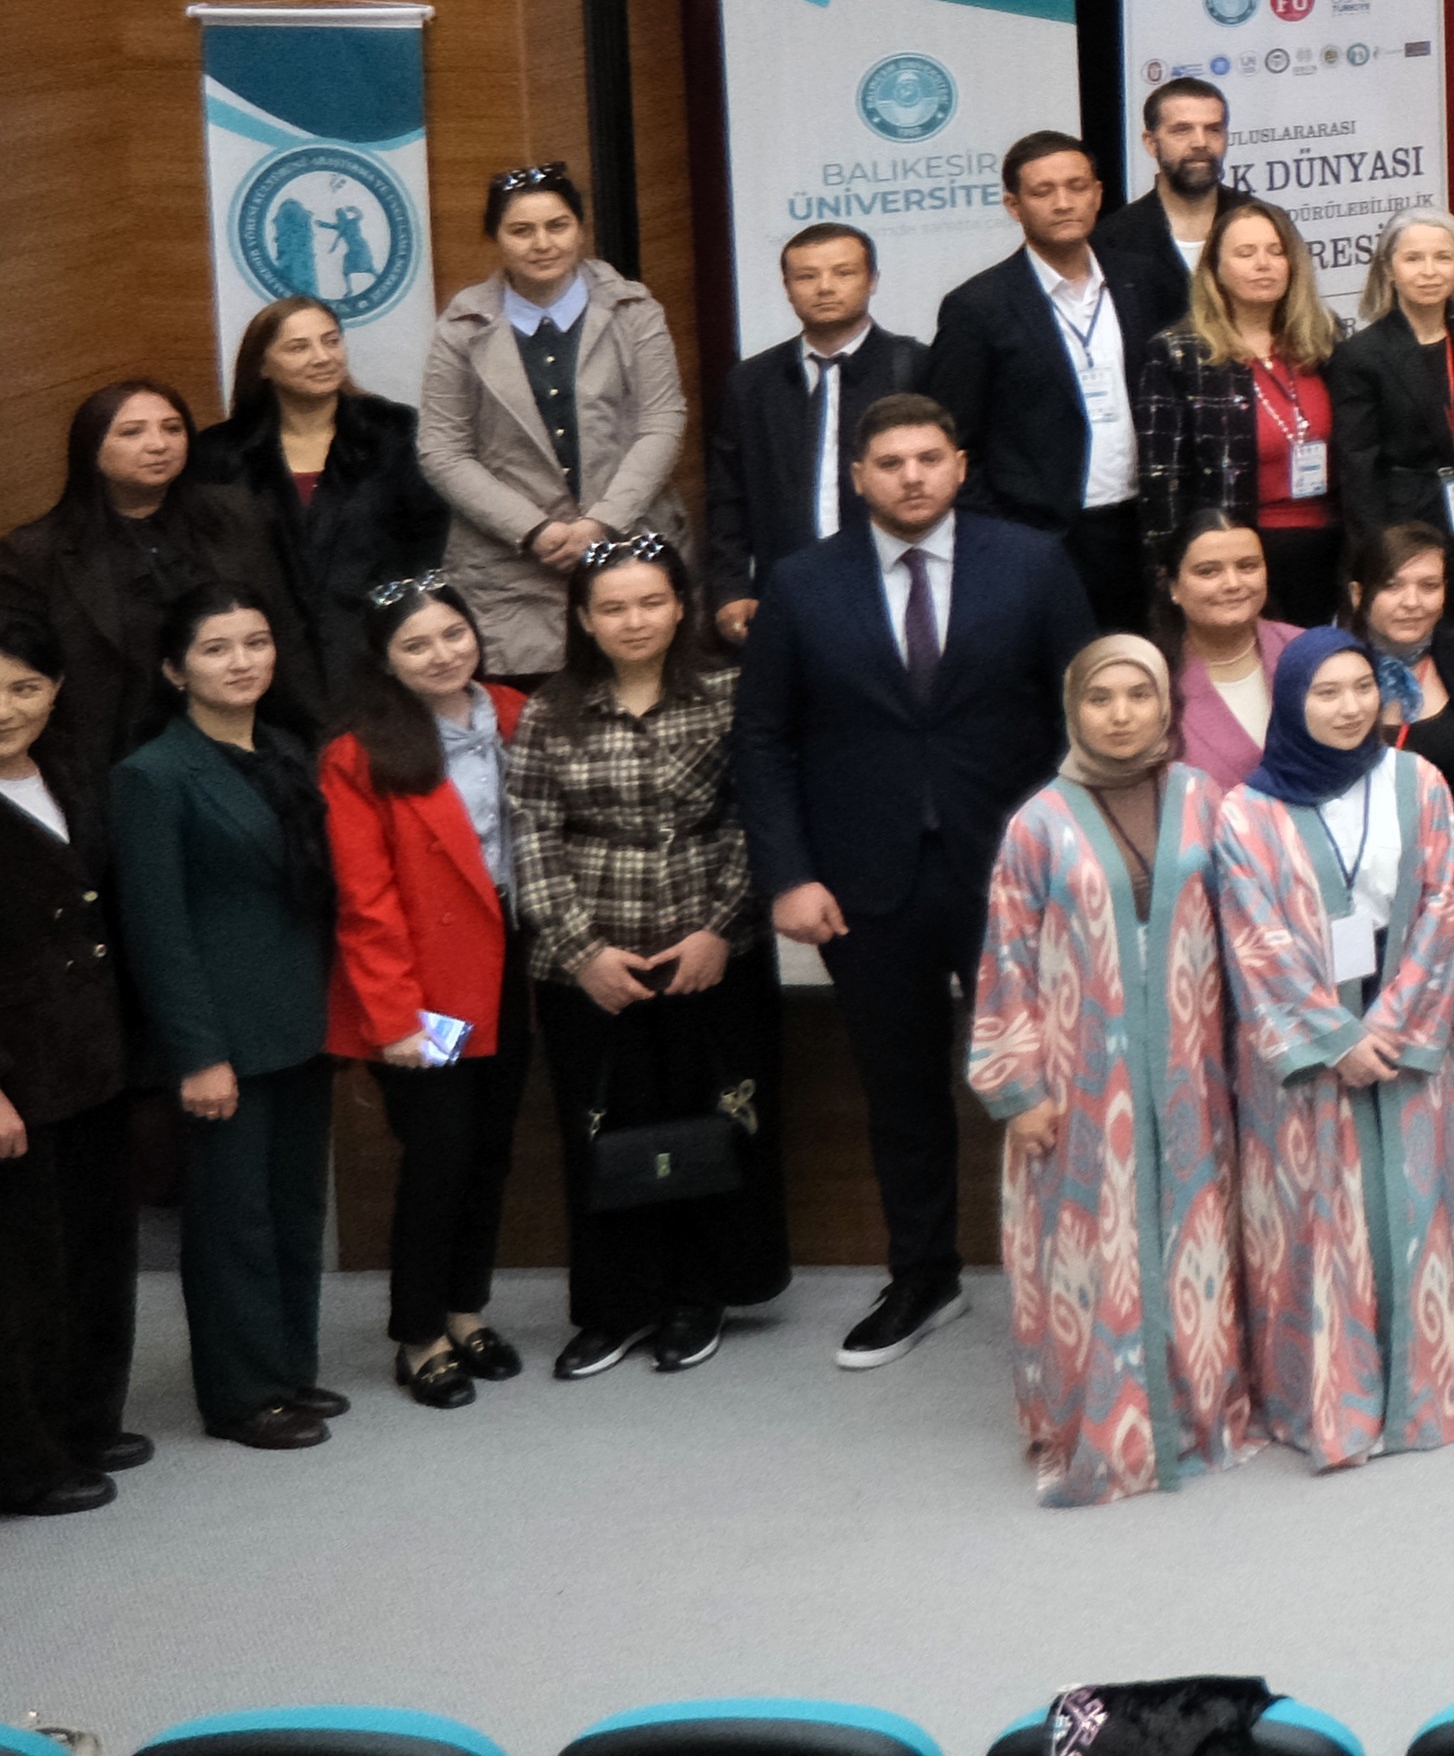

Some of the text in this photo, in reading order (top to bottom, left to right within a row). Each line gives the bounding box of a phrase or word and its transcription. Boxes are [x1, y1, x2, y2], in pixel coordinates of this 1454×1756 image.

[822, 149, 998, 187] BALIKESİR
[1266, 146, 1424, 192] DÜNYASI
[788, 180, 1001, 221] ÜNİVERSİTE
[1290, 192, 1434, 223] DÜRÜLEBİLİRLİK
